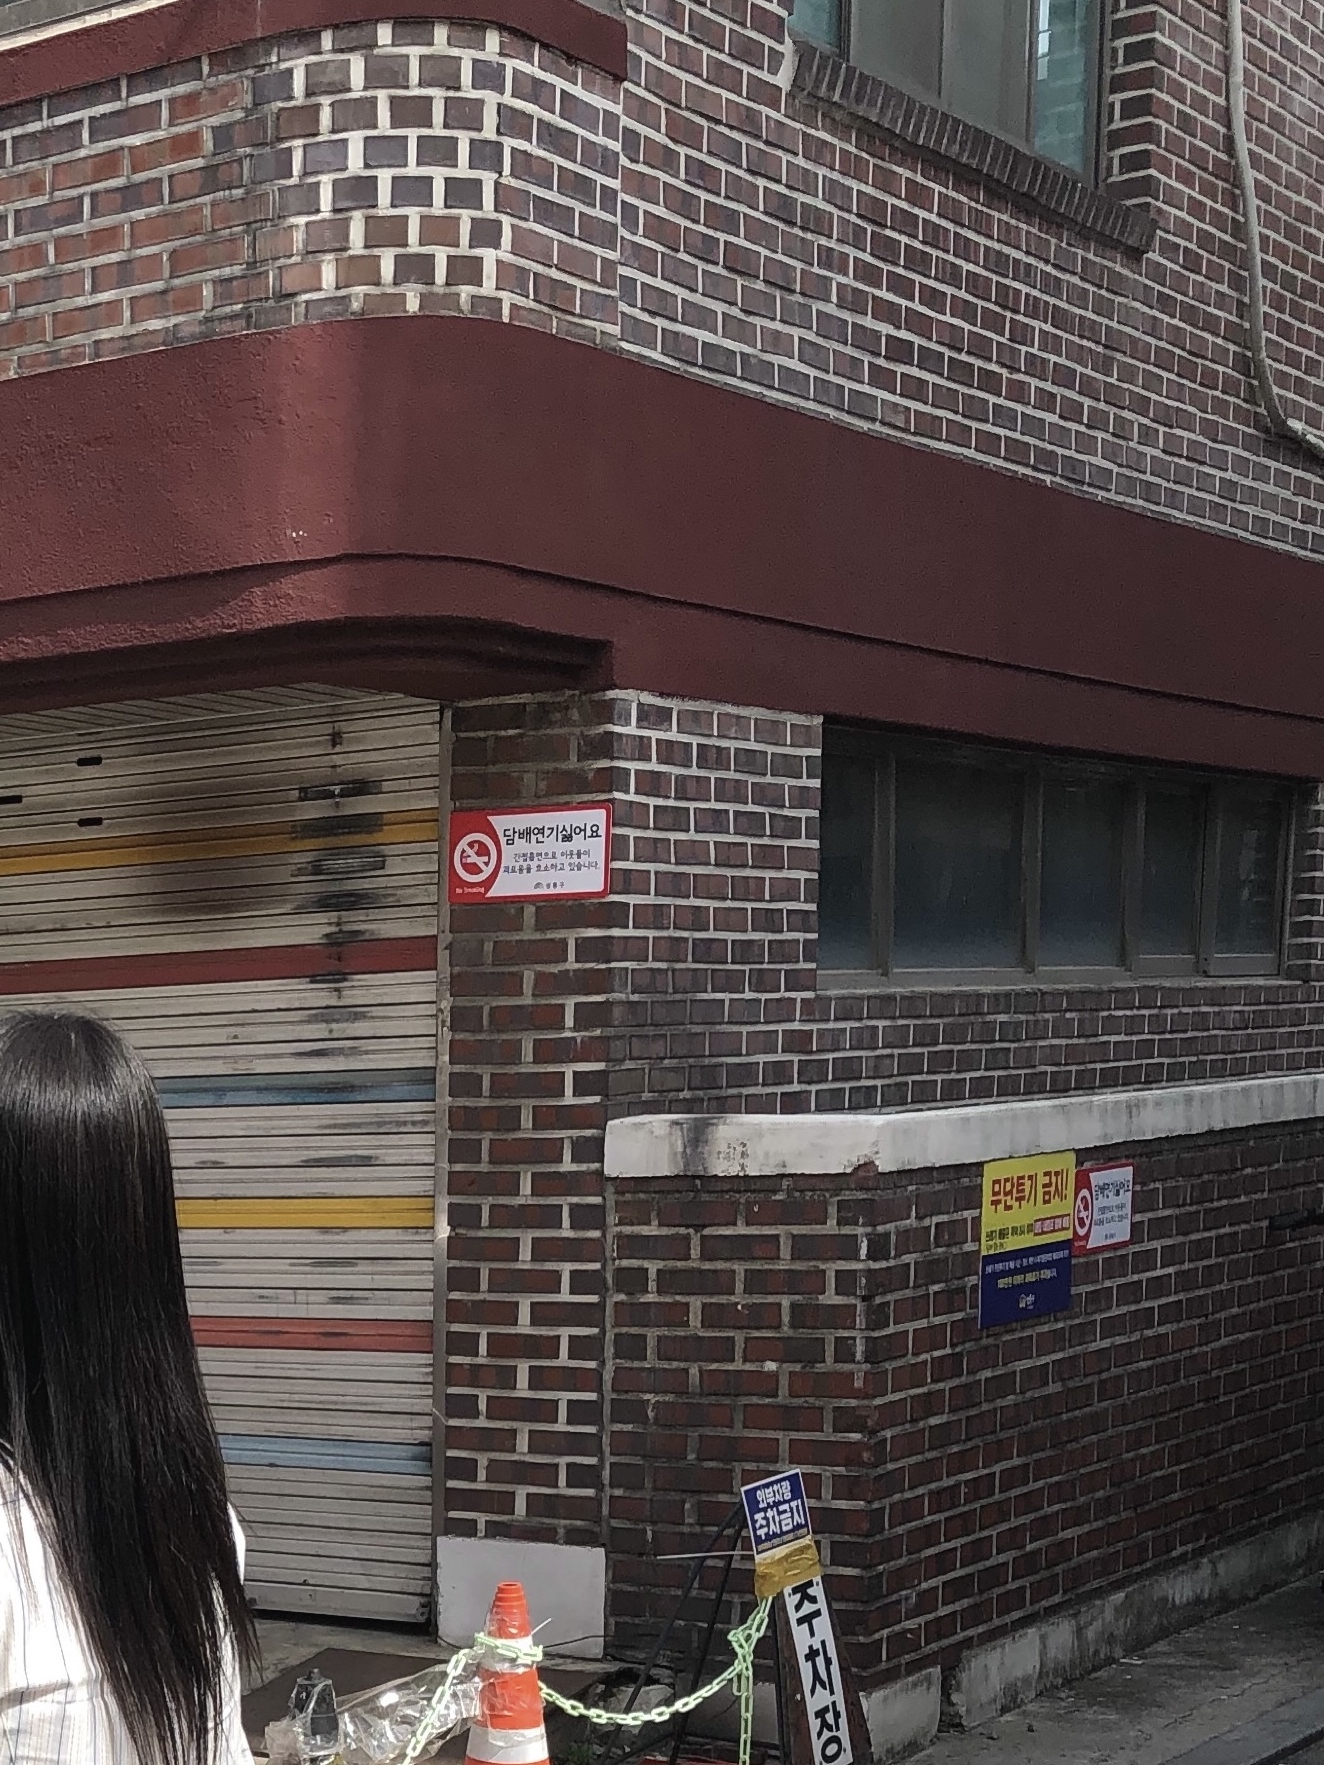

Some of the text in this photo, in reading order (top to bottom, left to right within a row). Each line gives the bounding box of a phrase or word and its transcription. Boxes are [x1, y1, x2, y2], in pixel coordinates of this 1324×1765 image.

[503, 823, 602, 846] 담배연기싫어요
[990, 1168, 1070, 1213] 무단투기 금지!
[756, 1480, 792, 1509] 외부차량
[753, 1498, 806, 1541] 주차금지
[791, 1578, 844, 1765] 주차장
